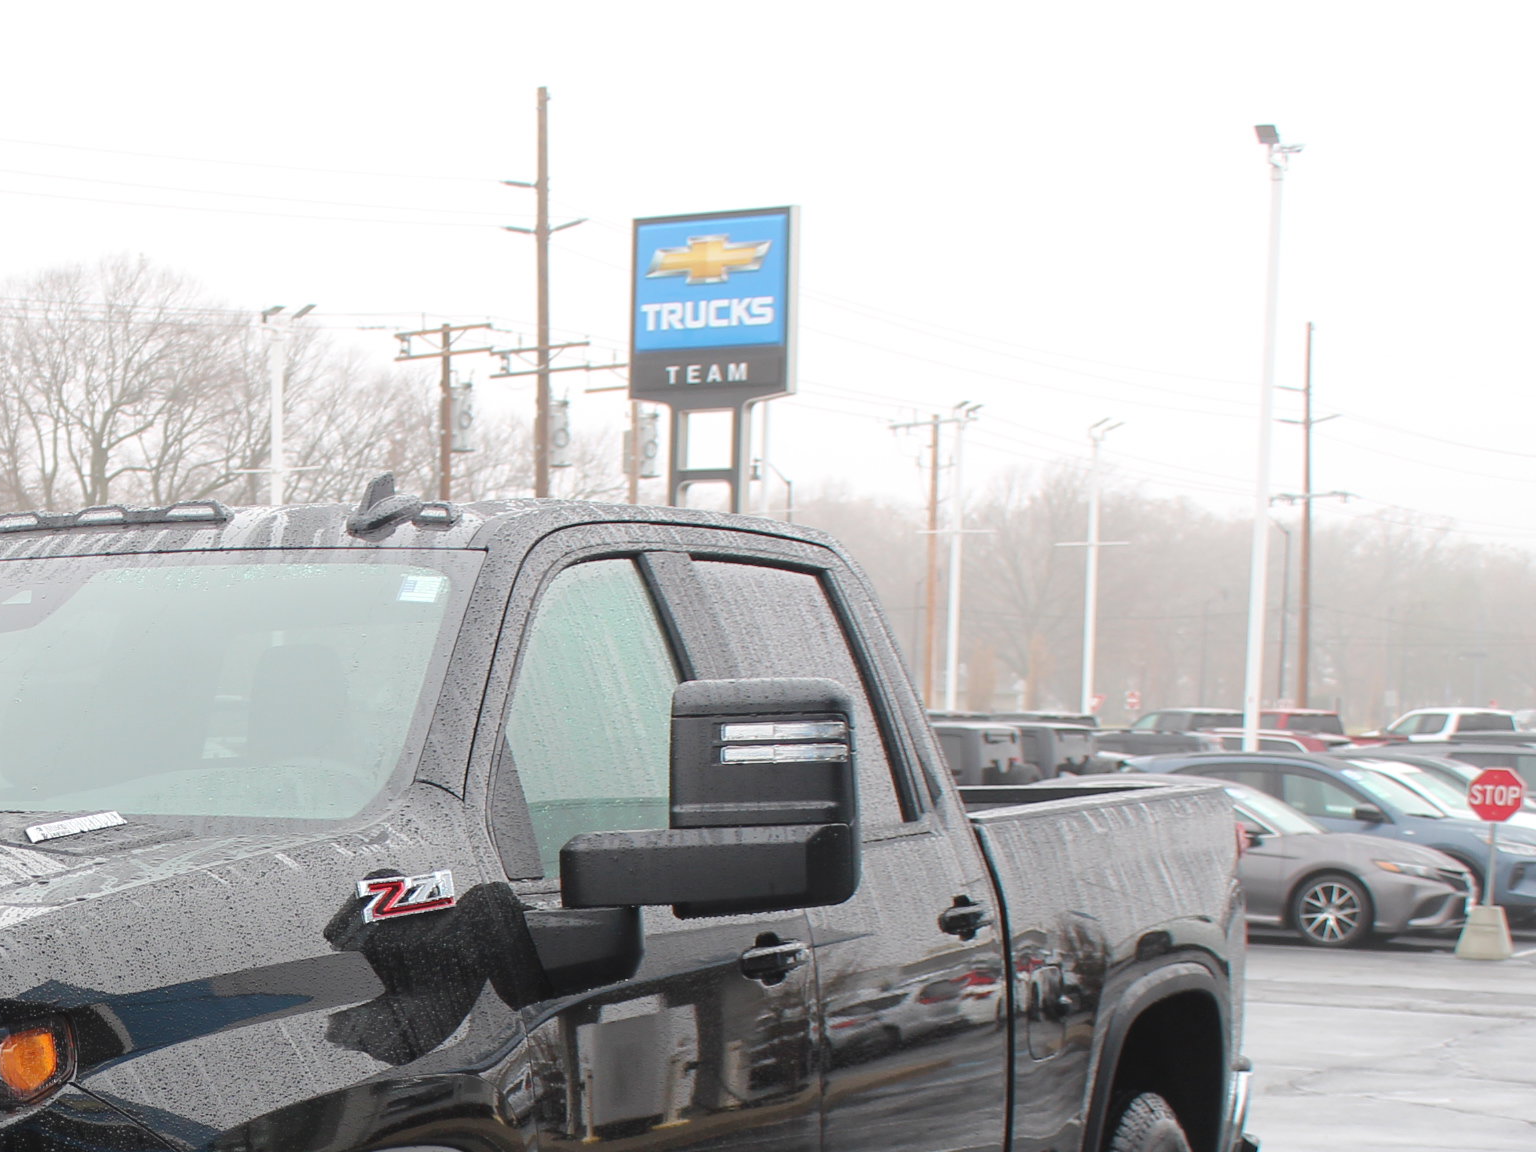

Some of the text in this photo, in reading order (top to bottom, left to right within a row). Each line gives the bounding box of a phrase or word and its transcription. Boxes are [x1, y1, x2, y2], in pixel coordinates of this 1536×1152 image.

[641, 296, 774, 331] TRUCKS
[665, 363, 748, 384] TEAM
[1469, 784, 1521, 806] STOP
[356, 869, 456, 923] Z71
